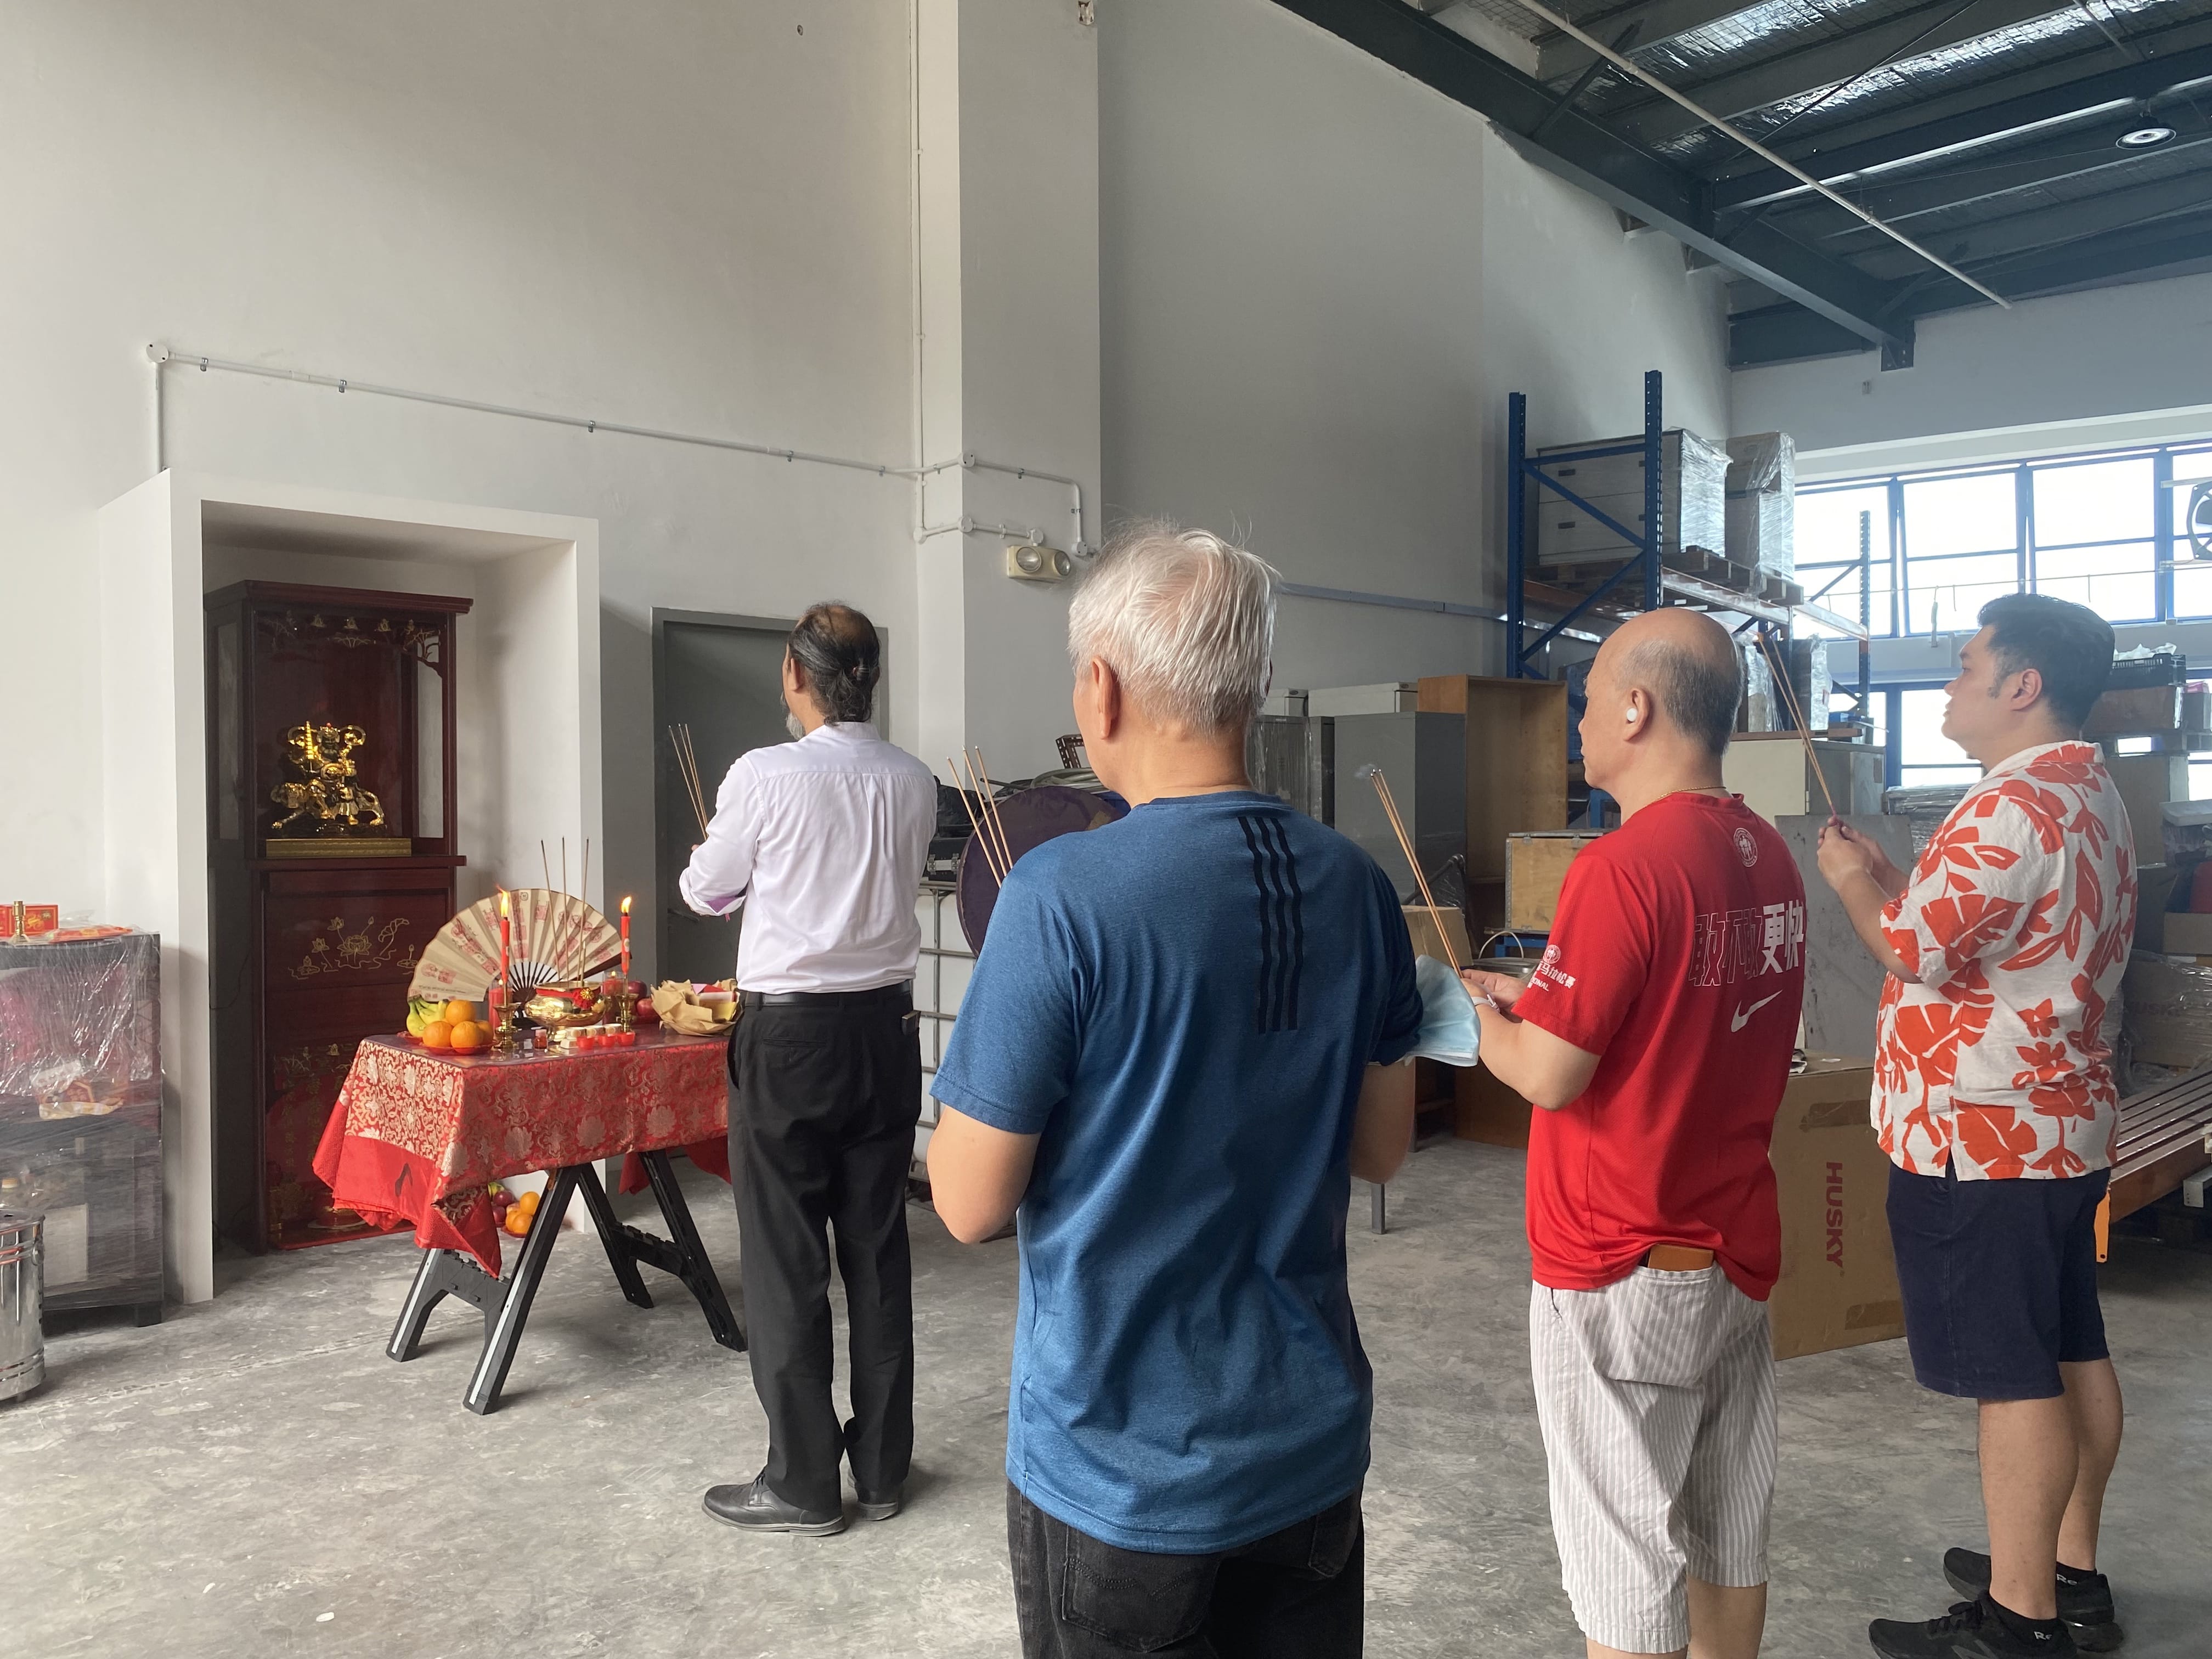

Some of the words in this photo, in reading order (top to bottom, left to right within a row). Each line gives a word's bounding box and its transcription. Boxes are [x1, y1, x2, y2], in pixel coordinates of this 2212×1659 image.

[1536, 960, 1576, 989] 马拉松赛
[1826, 1161, 1843, 1269] HUSKY
